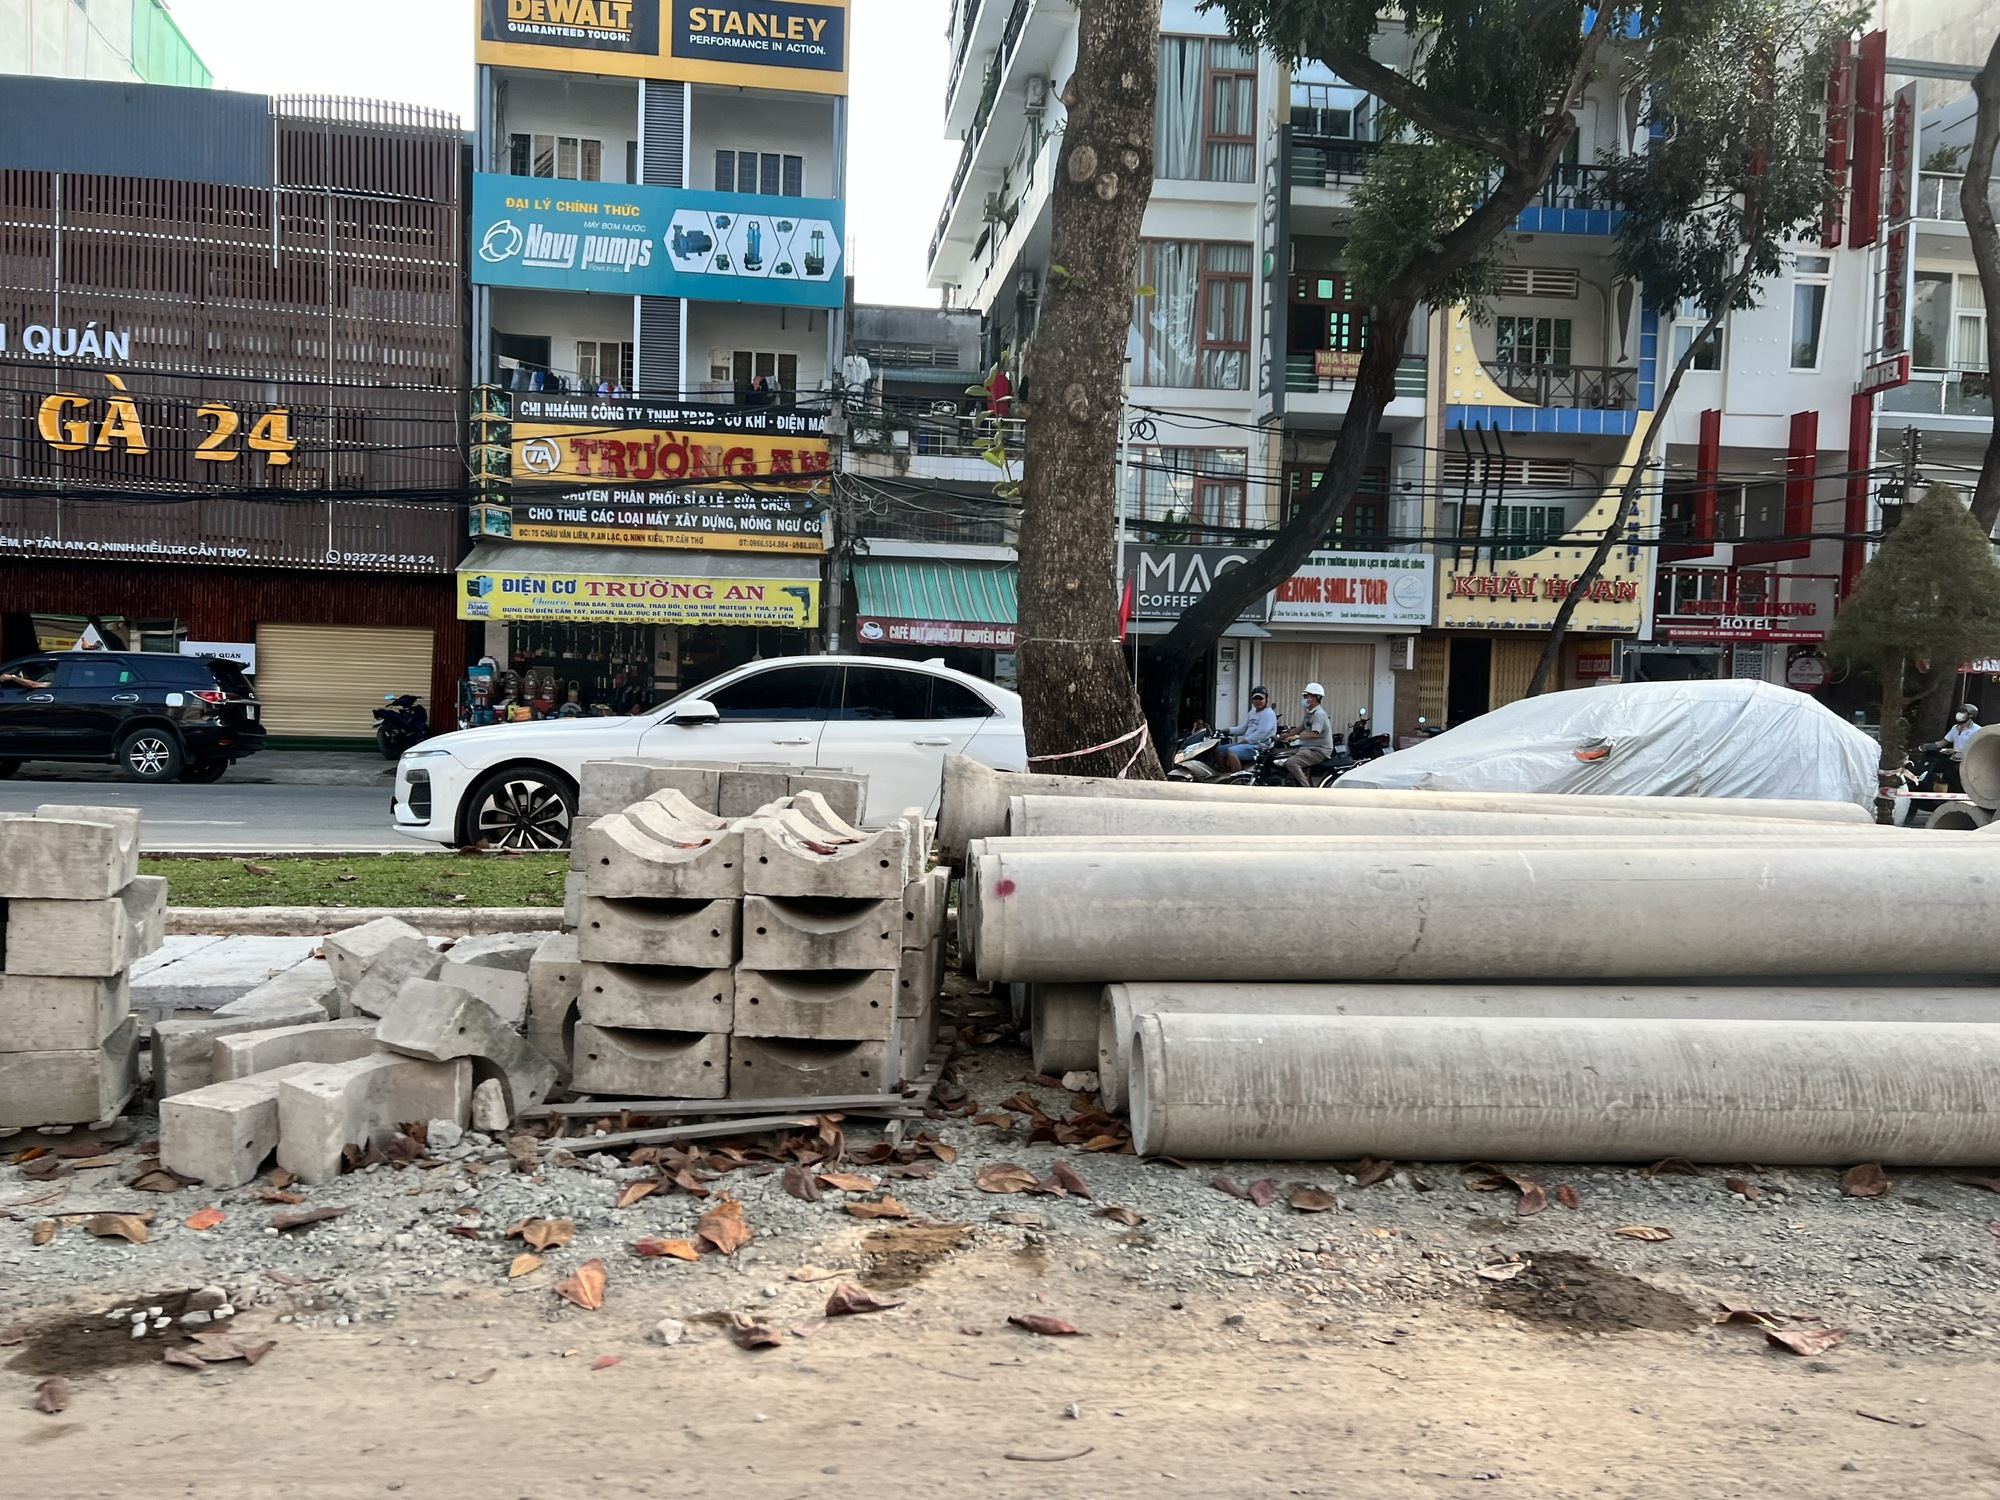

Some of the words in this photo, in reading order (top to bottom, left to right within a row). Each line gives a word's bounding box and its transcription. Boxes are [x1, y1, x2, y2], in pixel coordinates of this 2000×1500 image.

[508, 23, 585, 38] GUARANTEED
[689, 8, 828, 42] STANLEY
[689, 35, 769, 50] PERFORMANCE
[772, 41, 783, 51] IN
[786, 43, 827, 55] ACTION.
[506, 197, 529, 211] ĐẠI
[534, 197, 552, 210] LÝ
[556, 199, 598, 214] CHÍNH
[604, 203, 641, 217] THỨC
[581, 234, 653, 273] pumps
[22, 321, 129, 361] QUÁN
[38, 374, 150, 455] GÀ
[520, 401, 541, 416] CHI
[545, 400, 587, 419] NHÁNH
[591, 402, 624, 420] CÔNG
[626, 407, 642, 420] TY
[745, 412, 766, 428] KHÍ
[776, 413, 805, 434] ĐIỆN
[808, 416, 828, 433] MÁ
[195, 403, 298, 466] 24
[570, 431, 758, 480] TRƯỜNG
[770, 449, 829, 487] AN
[613, 488, 645, 504] PHÂN
[528, 507, 554, 521] CHO
[556, 508, 588, 522] THUÊ
[590, 507, 616, 523] CÁC
[618, 511, 644, 527] LOẠI
[646, 511, 671, 526] MÁY
[675, 511, 699, 527] XÂY
[702, 513, 738, 531] DỰNG,
[740, 515, 772, 531] NÔNG
[776, 516, 802, 532] NGƯ
[104, 543, 133, 552] NINH
[188, 542, 217, 556] CẦN
[219, 547, 247, 558] THƠ
[343, 552, 377, 562] 0327
[379, 554, 396, 562] 24
[399, 554, 416, 563] 24
[418, 555, 435, 564] 24
[501, 576, 546, 596] ĐIỆN
[552, 578, 577, 595] CƠ
[584, 579, 714, 600] TRƯỜNG
[723, 585, 766, 601] AN
[1324, 577, 1357, 604] SMILE
[1360, 578, 1389, 605] TOUR
[1453, 569, 1536, 598] KHẢI
[1719, 618, 1773, 631] HOTEL
[219, 651, 242, 659] QUÁN
